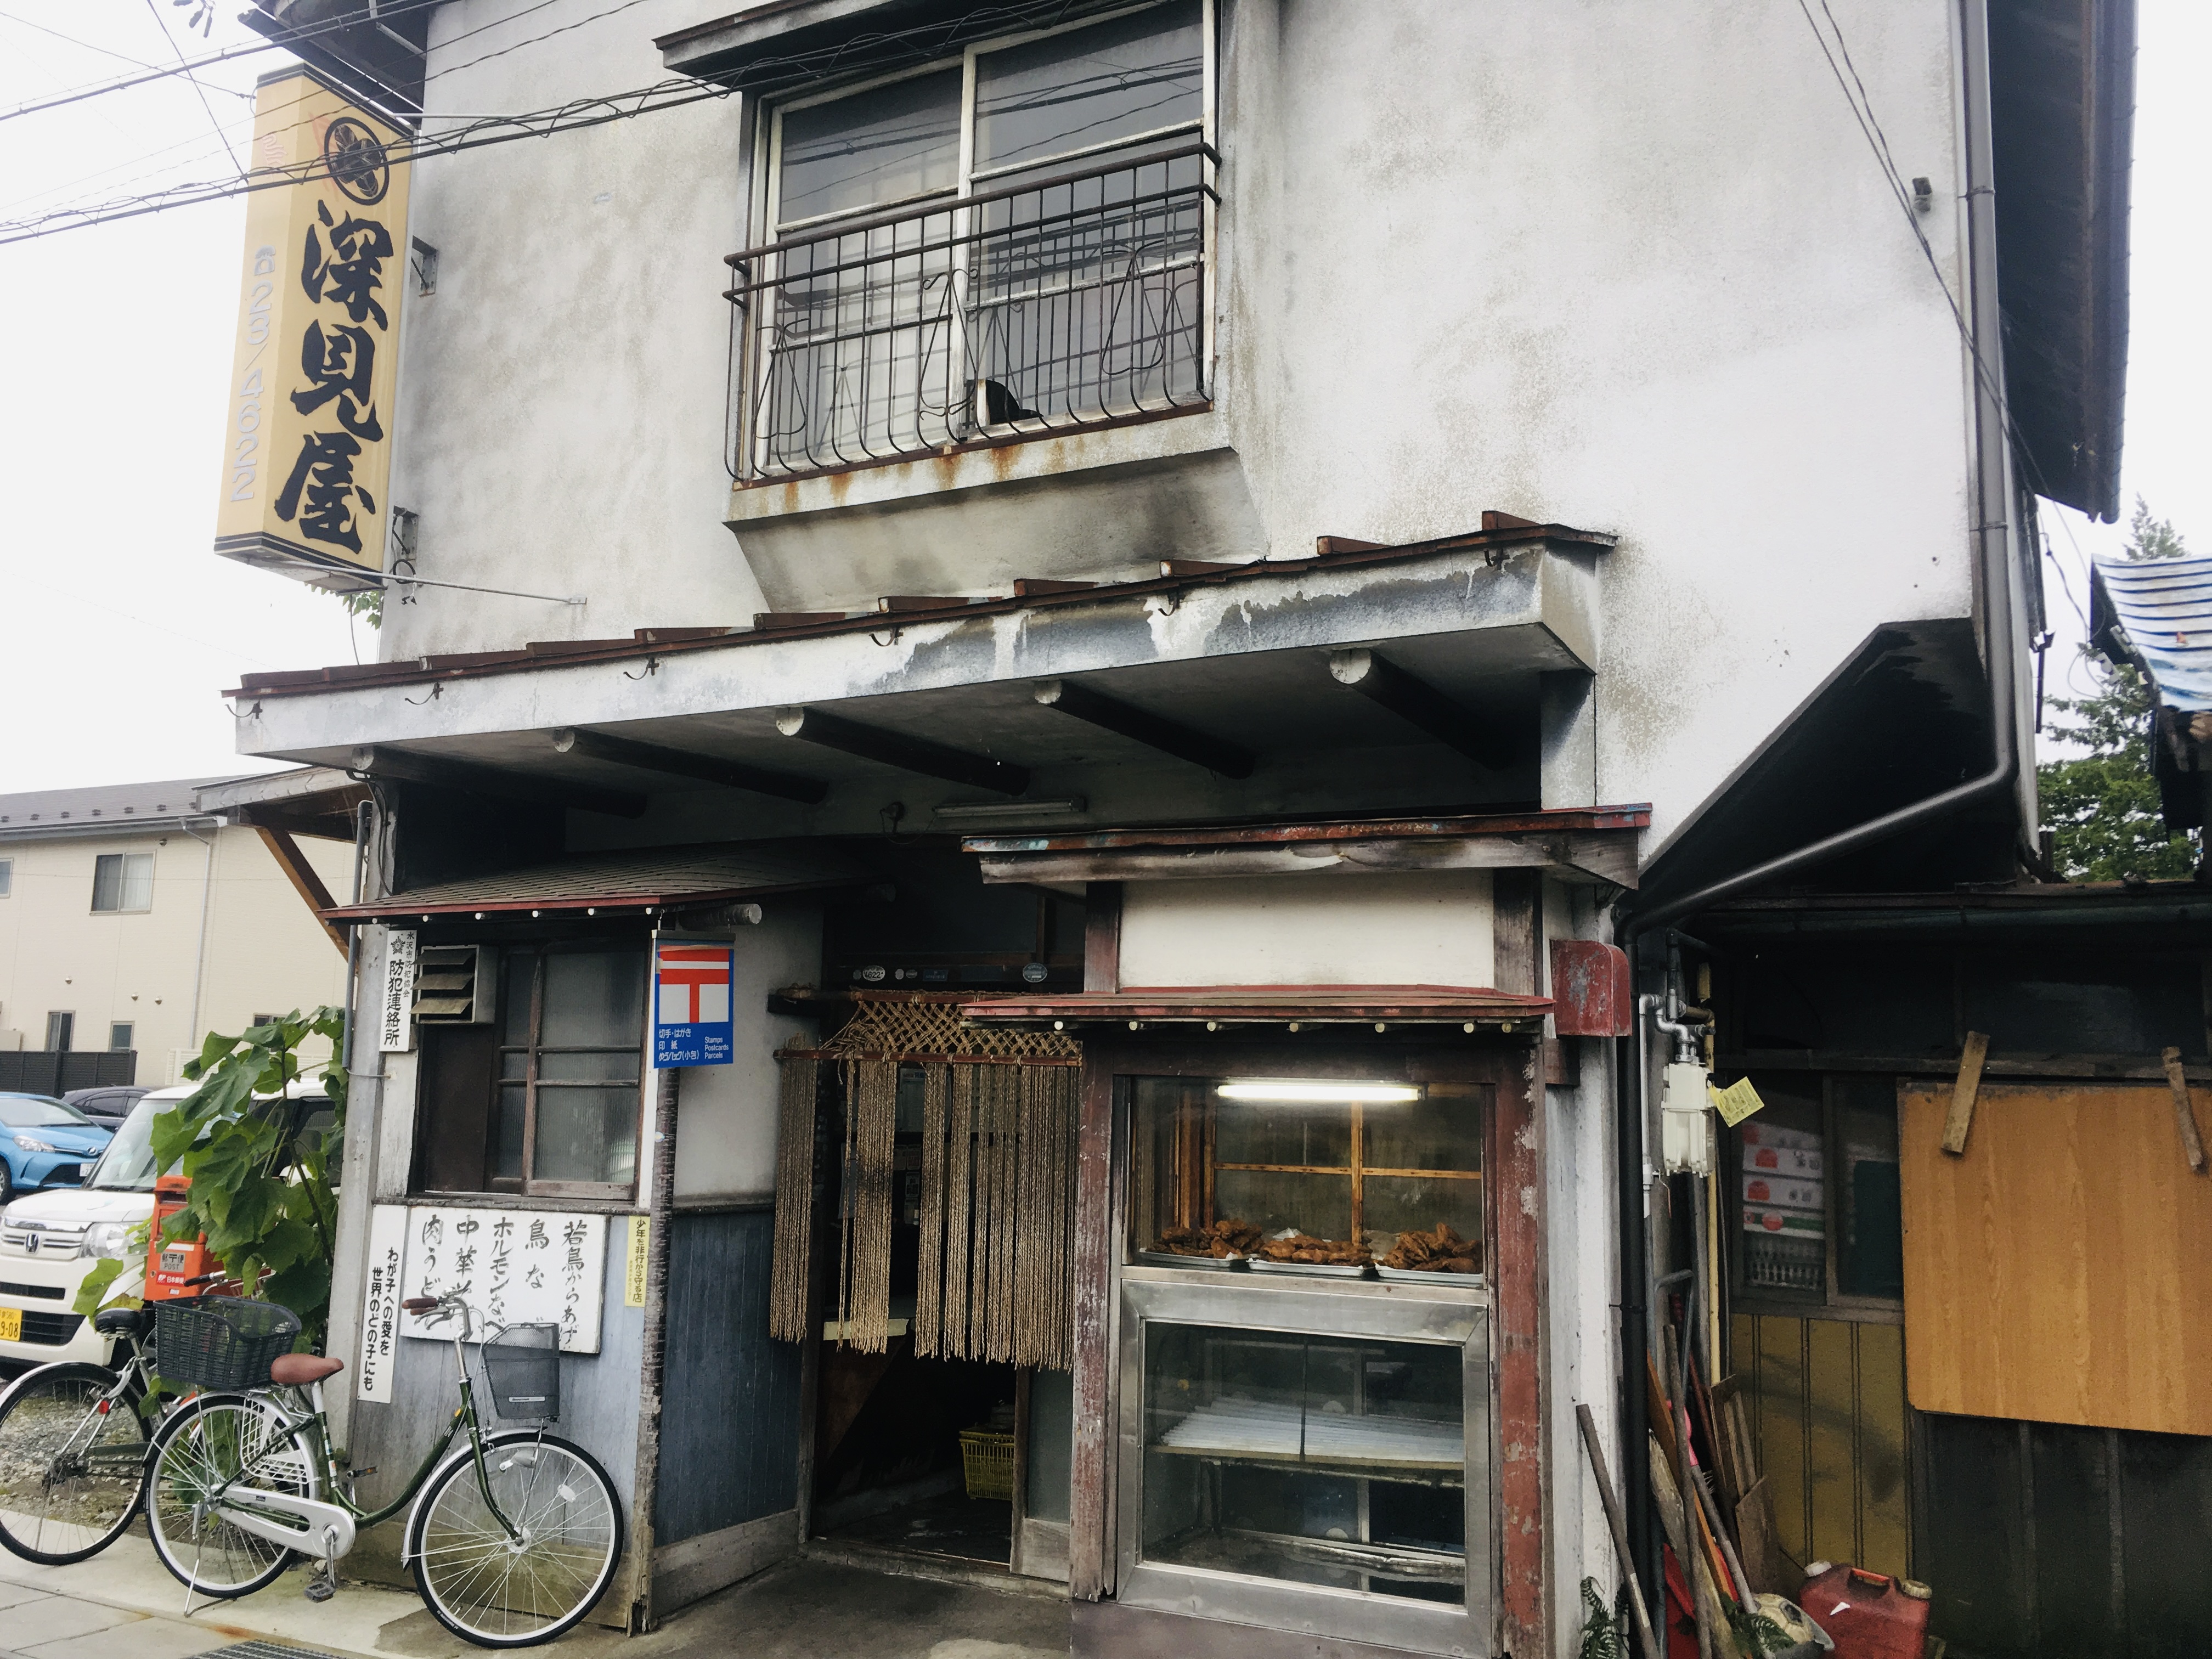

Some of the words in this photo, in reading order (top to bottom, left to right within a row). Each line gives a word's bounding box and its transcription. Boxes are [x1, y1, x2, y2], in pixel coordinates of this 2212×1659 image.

[274, 199, 393, 554] 深見屋
[384, 959, 405, 1046] 防犯連絡所
[380, 1246, 398, 1356] わが子への愛を
[421, 1214, 443, 1327] 肉うど
[633, 1218, 646, 1303] 少年を非行から守る店
[363, 1266, 383, 1391] 世界のどの子にも
